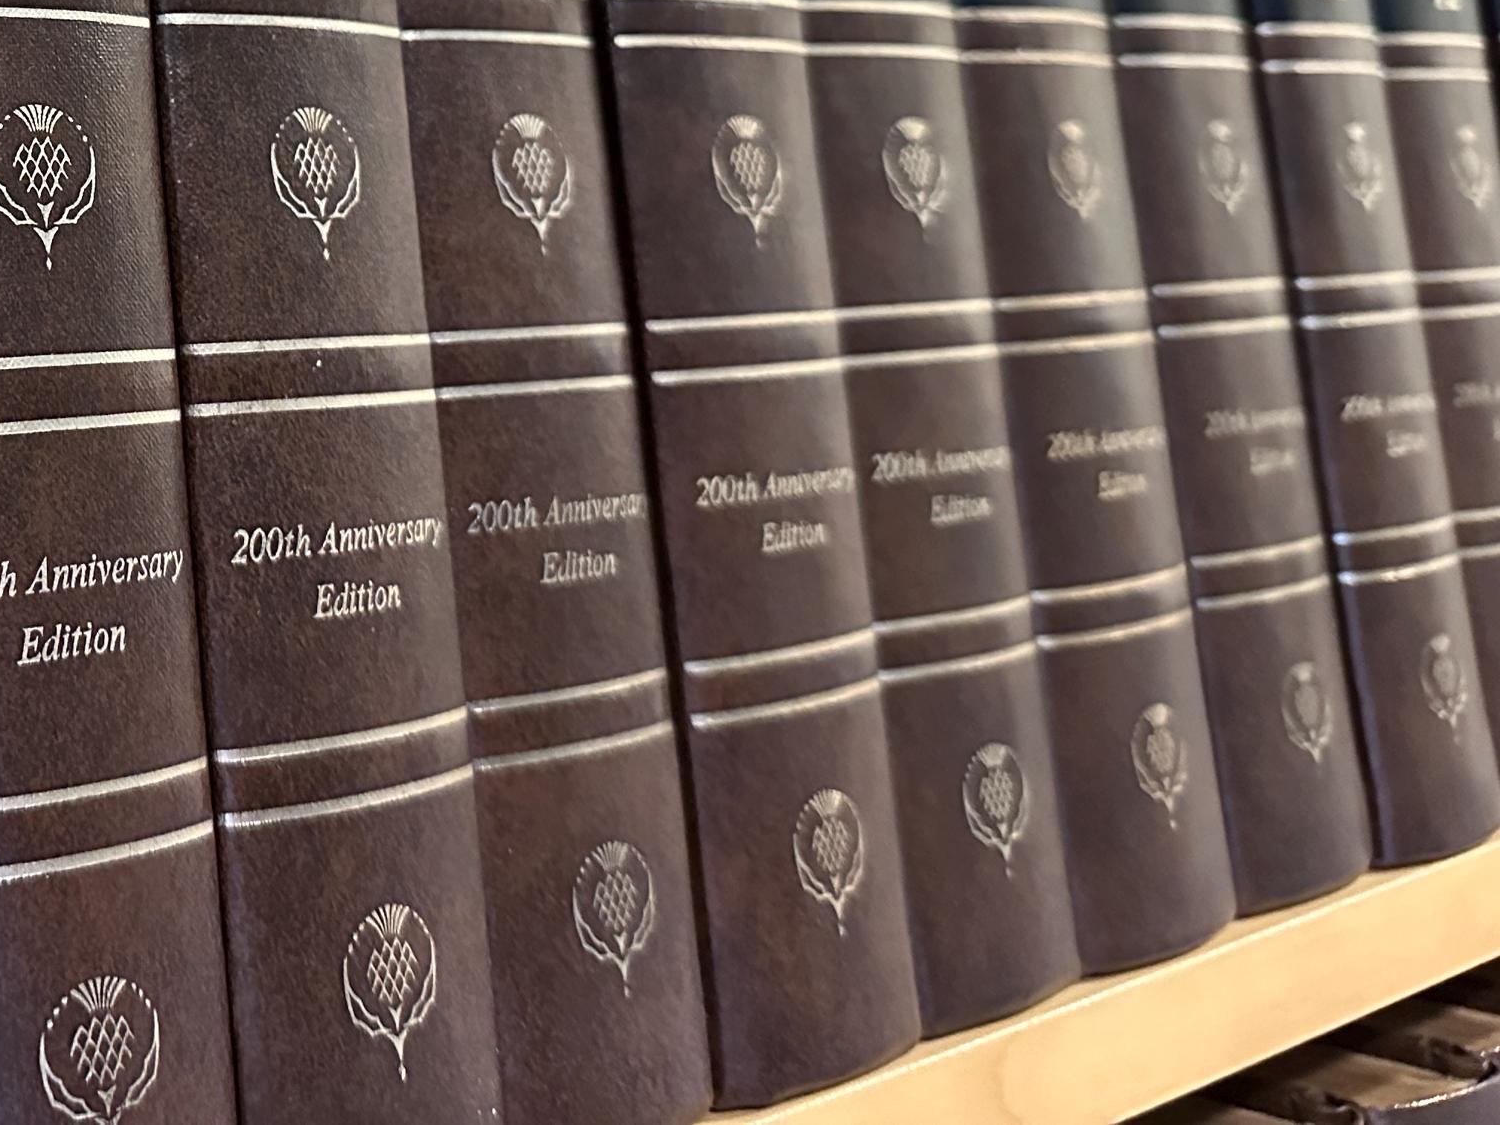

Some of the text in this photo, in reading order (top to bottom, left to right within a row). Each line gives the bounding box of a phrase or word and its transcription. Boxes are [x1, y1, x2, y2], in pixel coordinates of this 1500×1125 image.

[696, 472, 758, 509] 200th
[467, 496, 538, 535] 200th
[231, 517, 442, 565] 200th Anniversary
[762, 521, 826, 554] Edition
[25, 549, 184, 596] Anniversary
[540, 549, 616, 585] Edition
[313, 580, 400, 619] Edition
[17, 622, 126, 666] Edition
